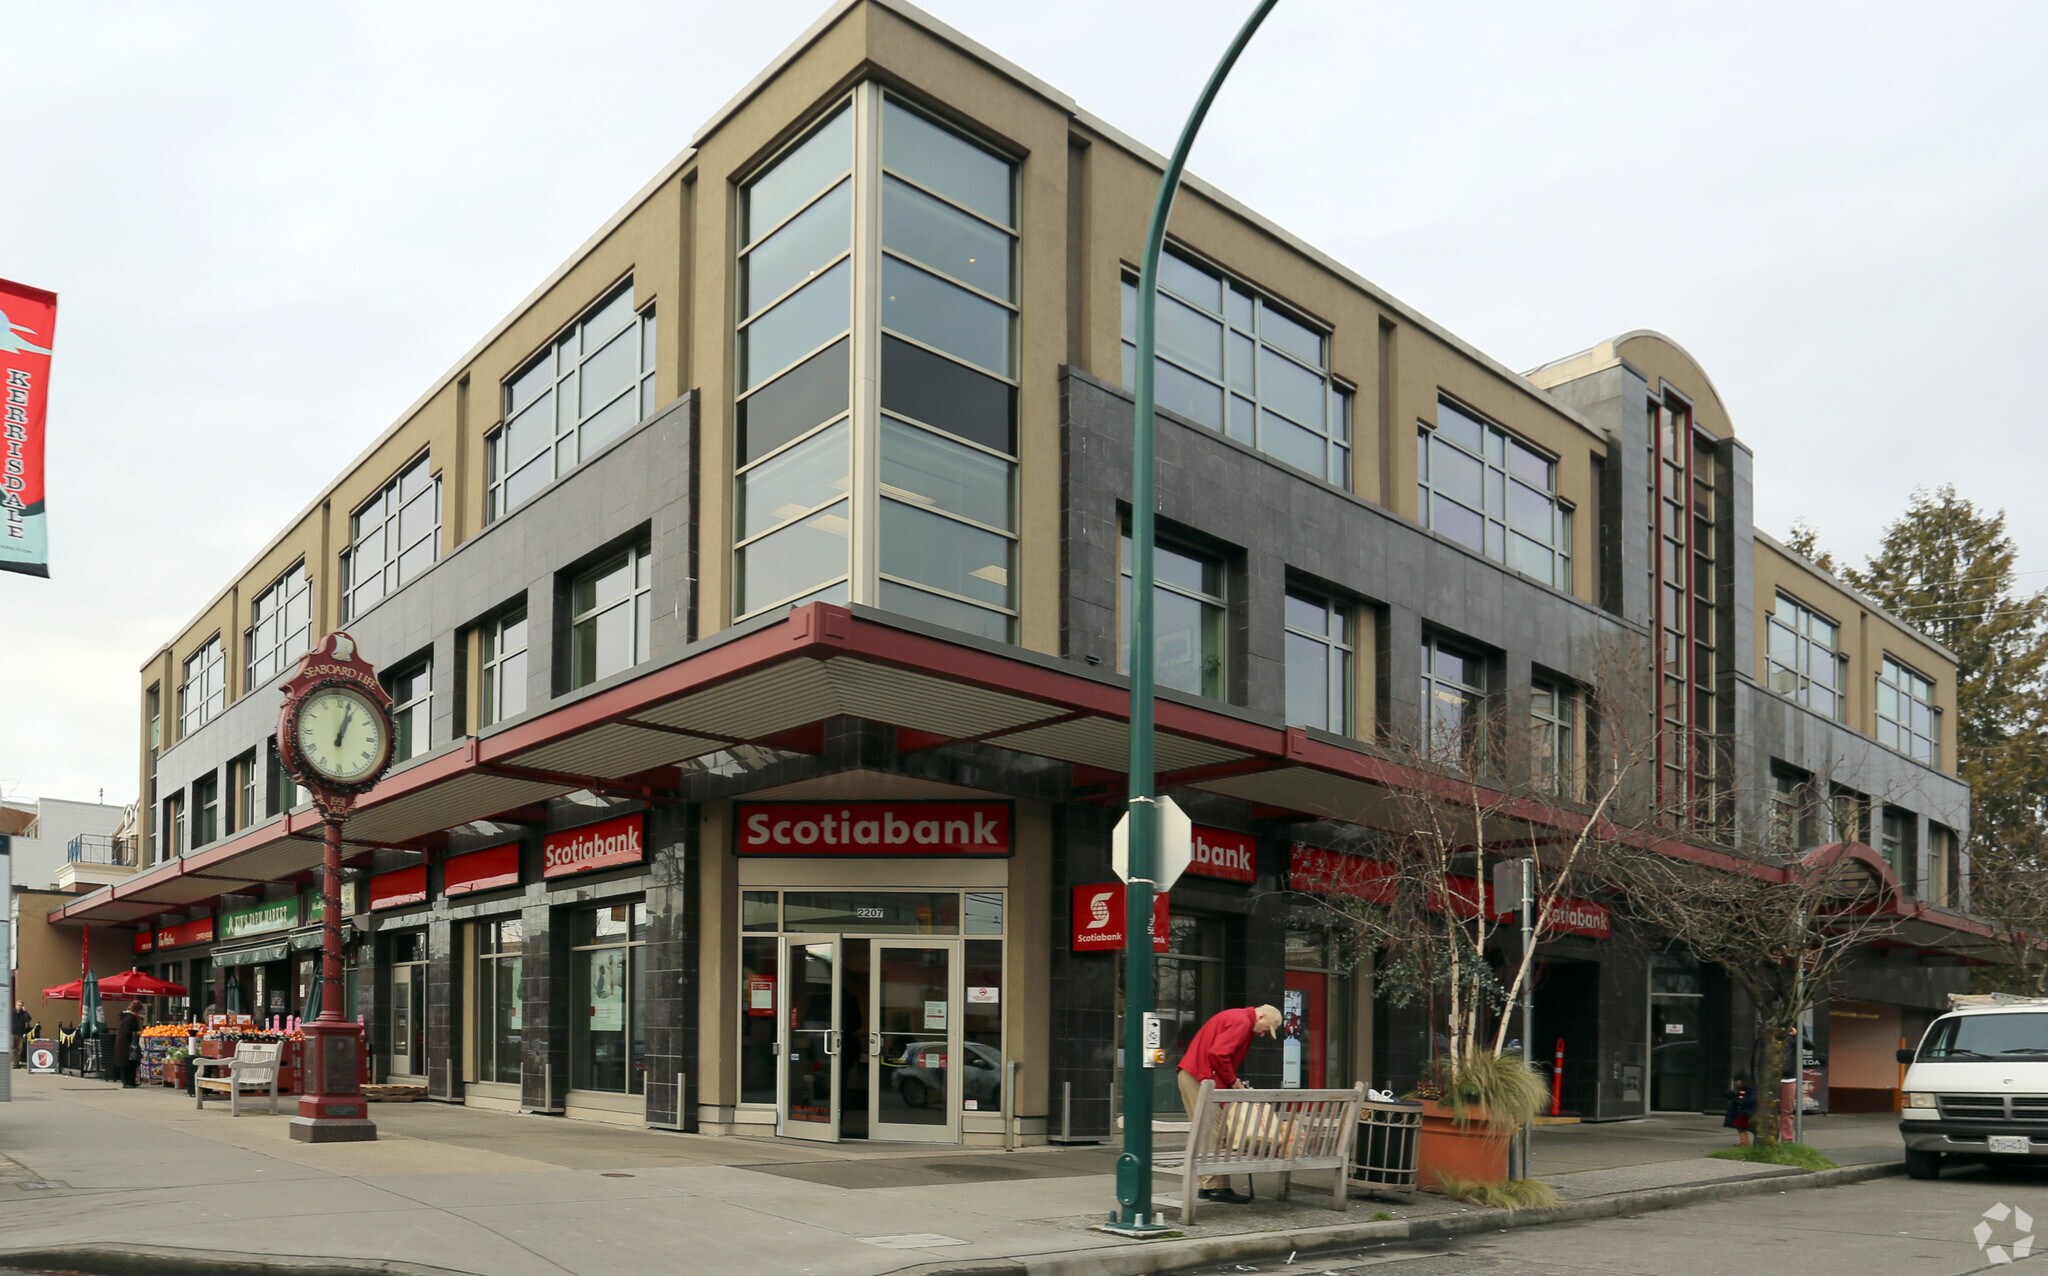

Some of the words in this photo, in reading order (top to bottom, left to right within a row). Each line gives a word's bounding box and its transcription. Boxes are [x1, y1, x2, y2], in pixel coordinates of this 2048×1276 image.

[6, 369, 30, 540] KERRISDALE
[303, 664, 357, 679] SEABOARD
[357, 672, 377, 690] LIFE
[745, 810, 999, 846] Scotiabank
[545, 825, 639, 868] Scotiabank
[857, 907, 884, 918] 2207
[1078, 932, 1122, 943] Scotiabank
